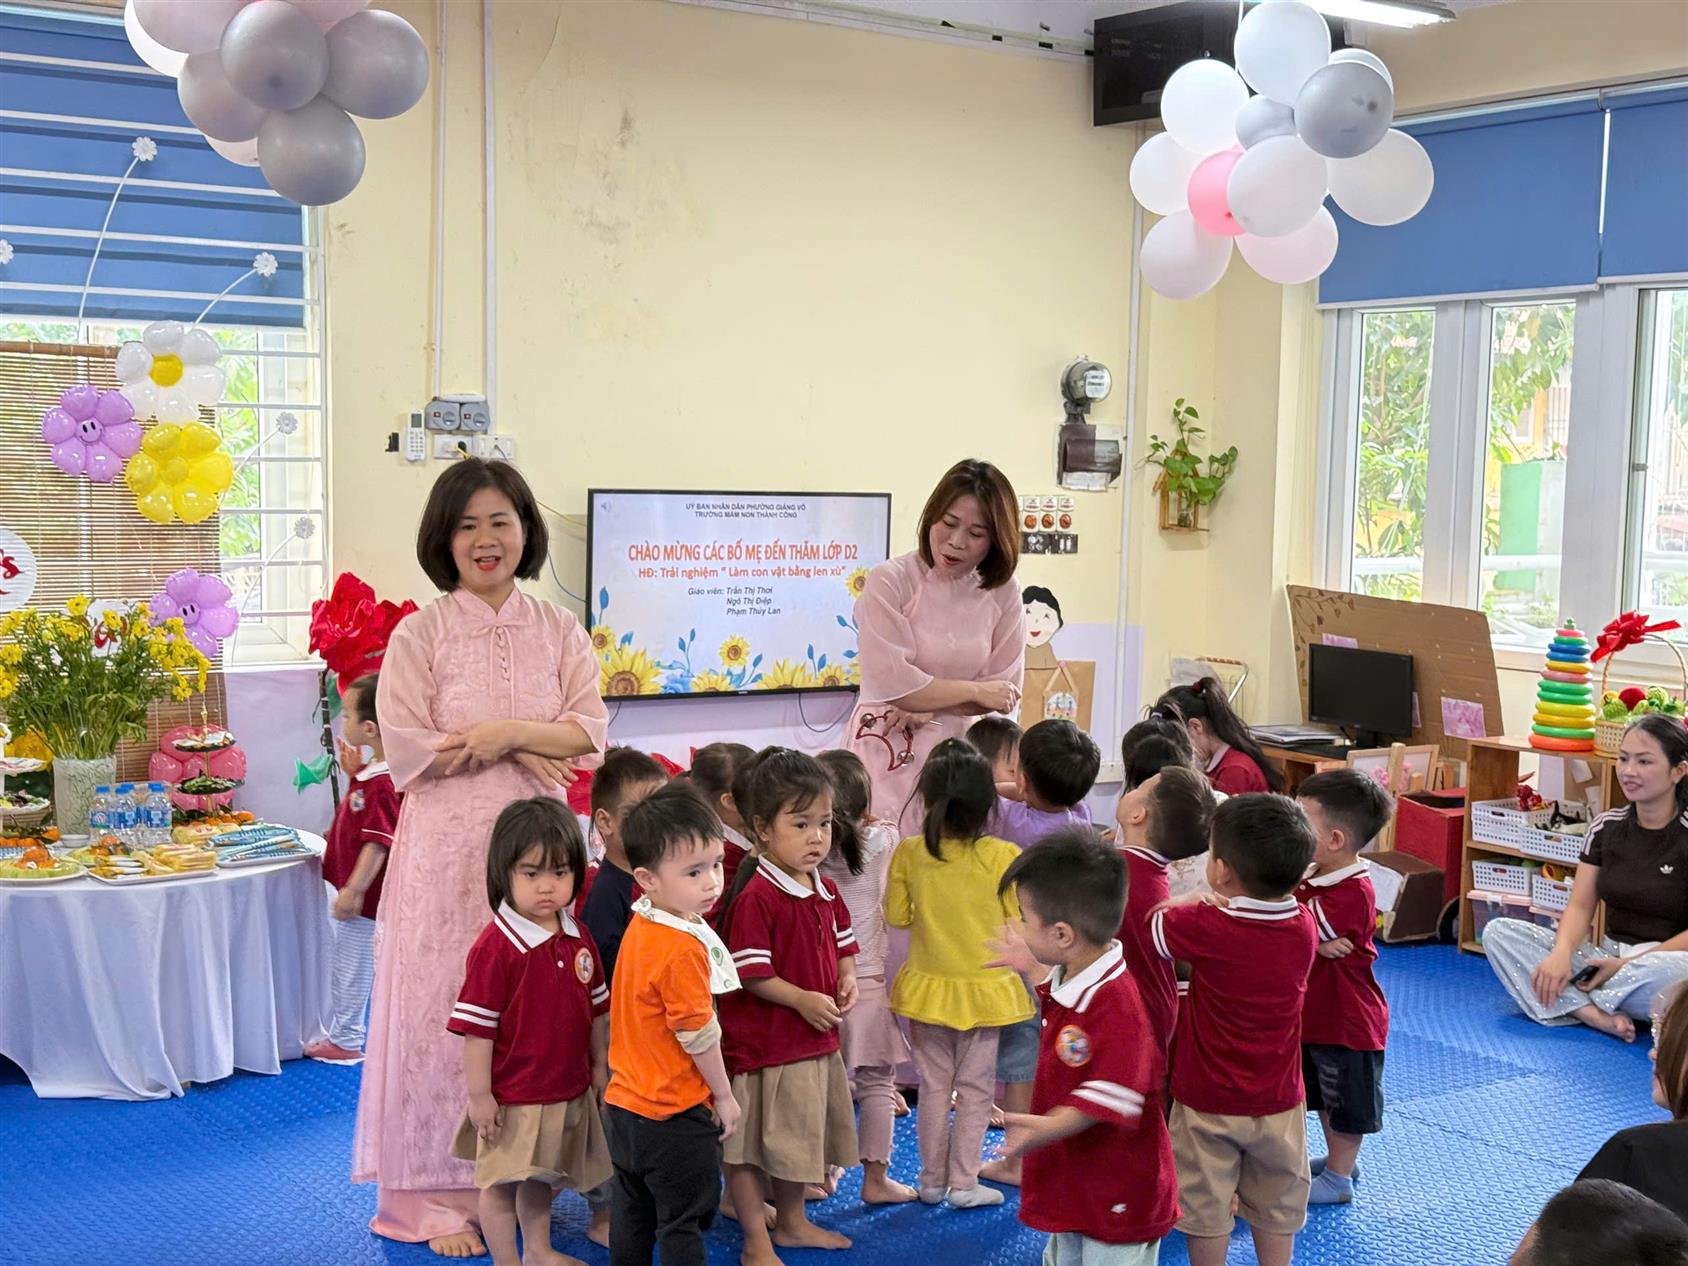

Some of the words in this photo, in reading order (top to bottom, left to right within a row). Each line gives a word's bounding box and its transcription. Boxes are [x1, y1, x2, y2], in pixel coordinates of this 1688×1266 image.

[628, 540, 660, 561] CHÀO
[663, 540, 701, 561] MỪNG
[703, 540, 725, 561] CÁC
[727, 538, 743, 561] BỐ
[745, 544, 761, 564] MẸ
[764, 538, 786, 560] ĐẾN
[789, 541, 820, 560] THĂM
[823, 540, 842, 560] LỚP
[844, 544, 858, 560] D2
[639, 567, 658, 578] HĐ:
[681, 566, 719, 580] nghiệm
[729, 566, 749, 577] Làm
[751, 568, 769, 577] con
[771, 566, 786, 579] vật
[788, 565, 811, 578] bằng
[813, 566, 828, 577] len
[687, 587, 706, 596] Giáo
[707, 587, 725, 595] viên:
[744, 586, 756, 596] Thị
[743, 597, 755, 606] Thị
[726, 607, 747, 616] Phạm
[767, 607, 781, 615] Lan
